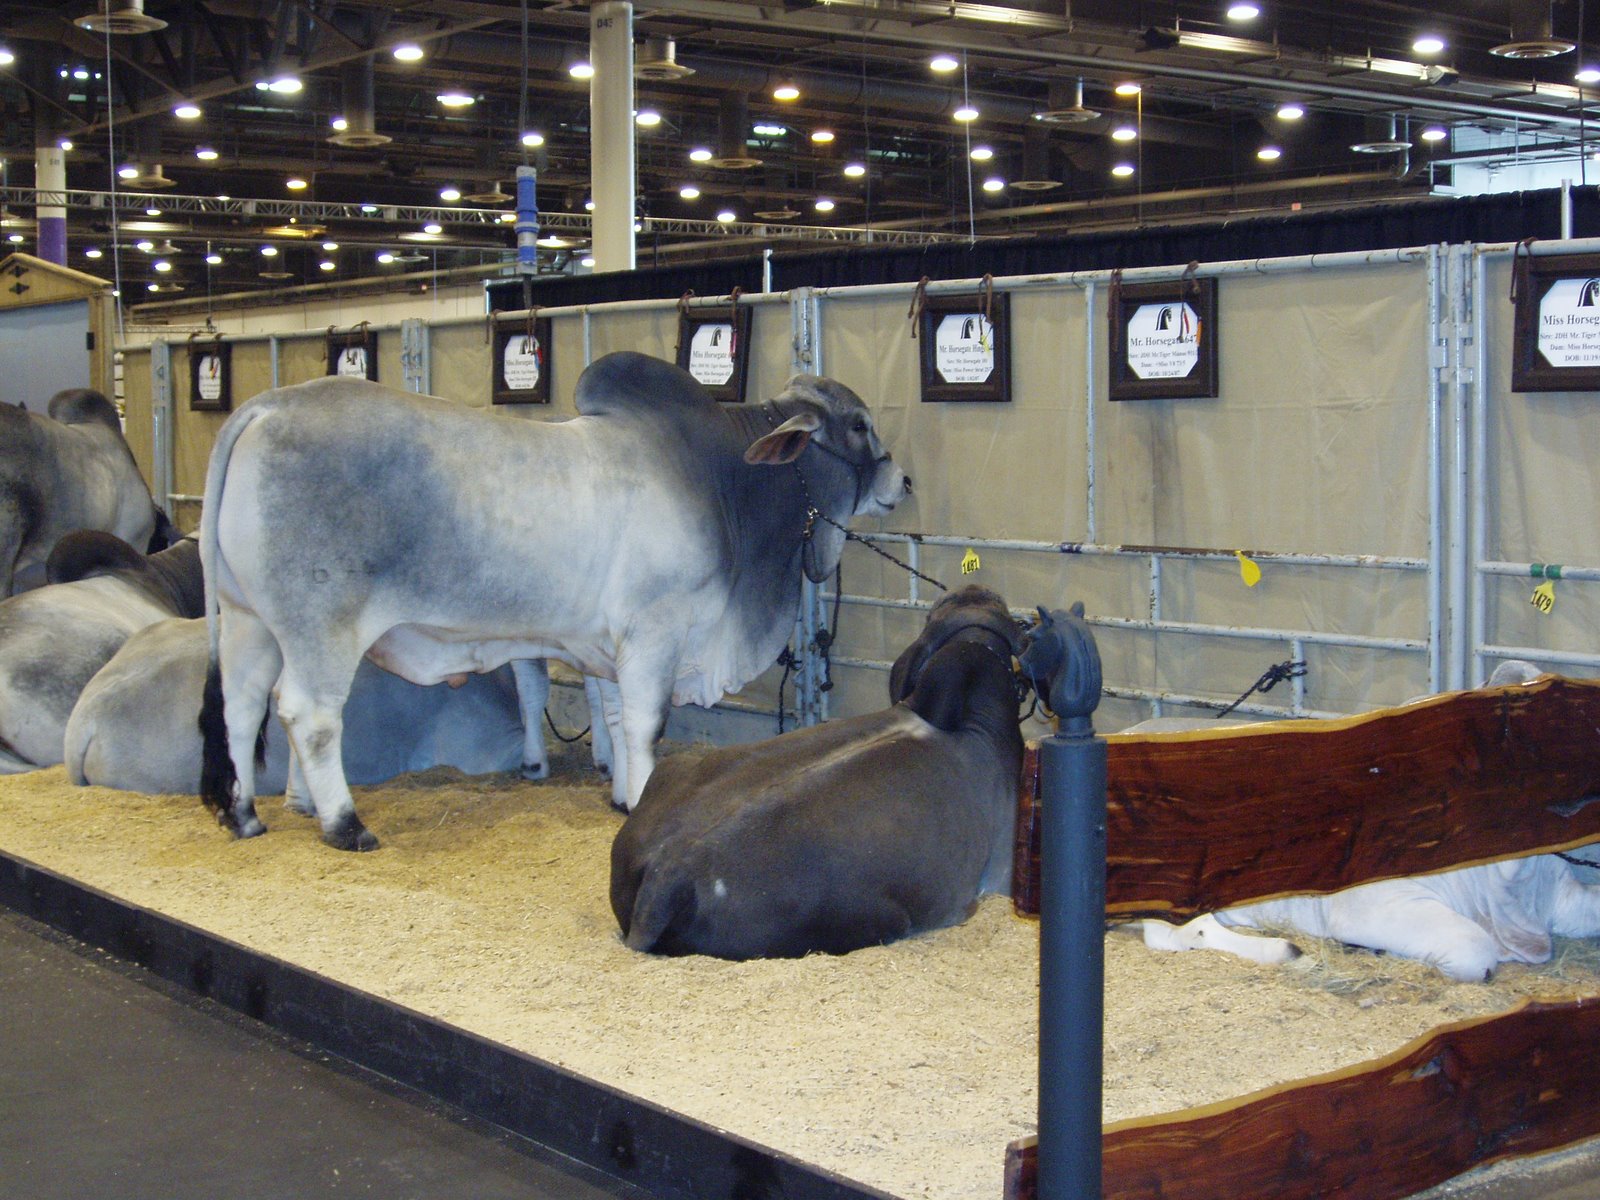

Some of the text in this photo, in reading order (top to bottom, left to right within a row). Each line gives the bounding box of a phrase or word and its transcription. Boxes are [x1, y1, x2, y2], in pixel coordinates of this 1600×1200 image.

[1543, 315, 1564, 326] Miss
[1581, 332, 1597, 340] Tiger
[1131, 338, 1143, 346] Mr.
